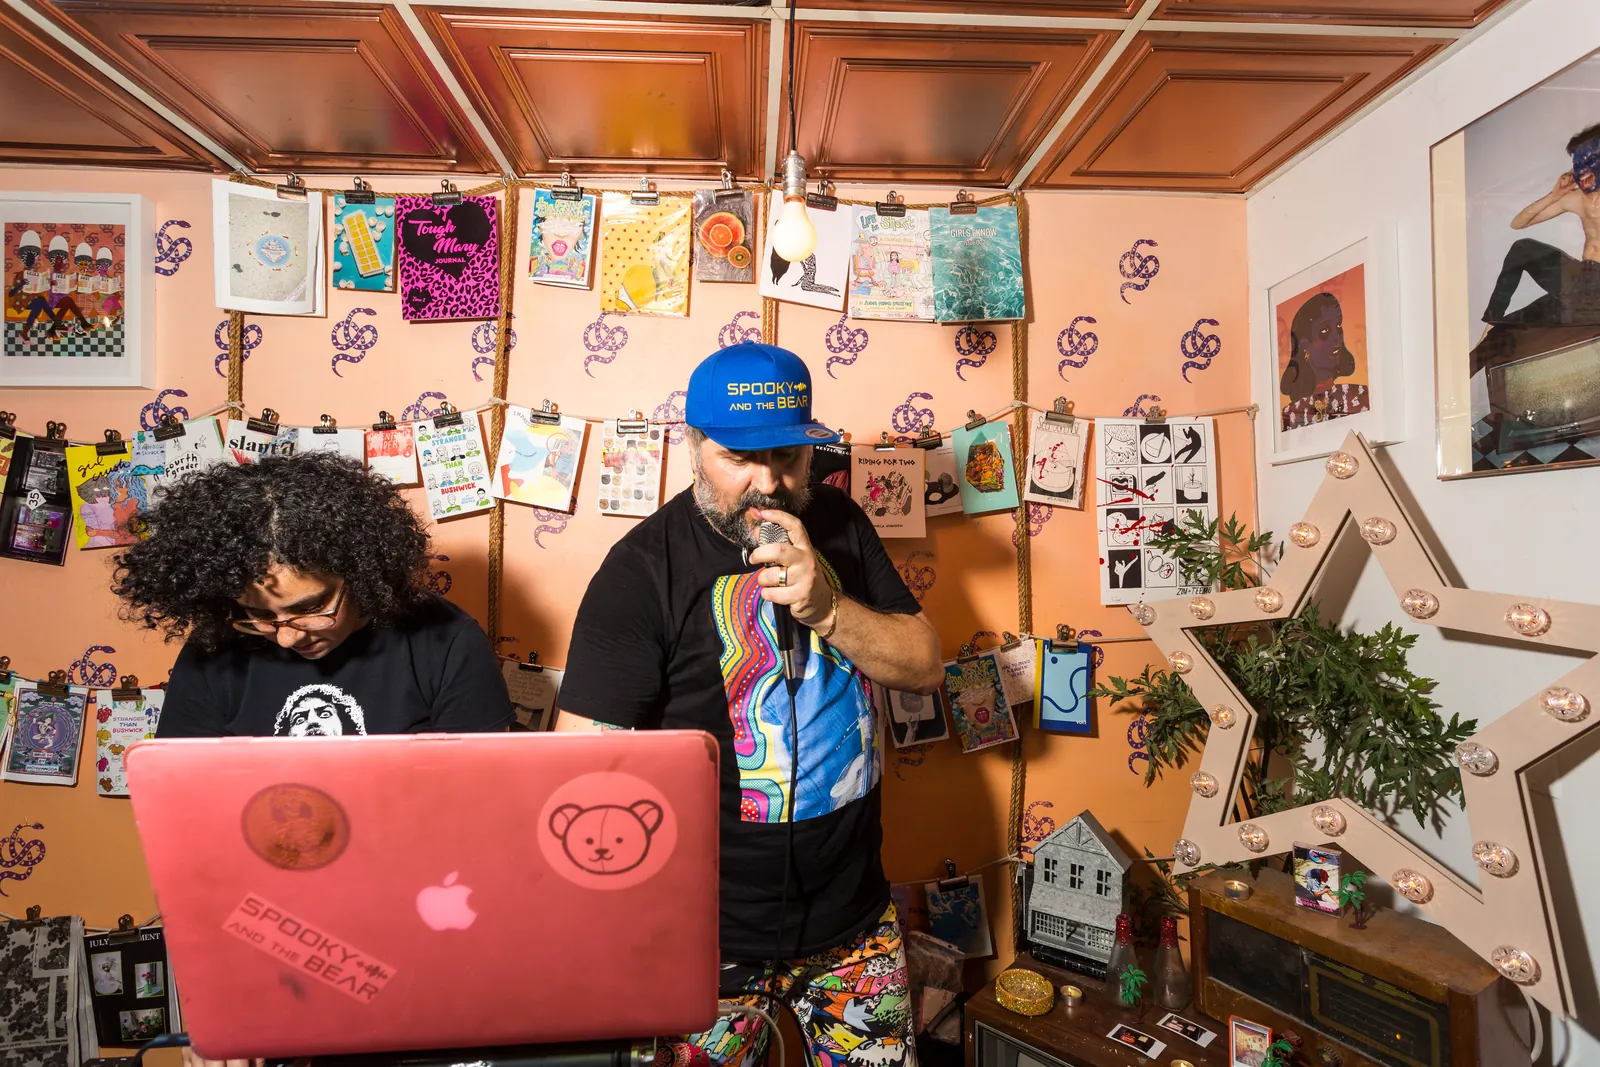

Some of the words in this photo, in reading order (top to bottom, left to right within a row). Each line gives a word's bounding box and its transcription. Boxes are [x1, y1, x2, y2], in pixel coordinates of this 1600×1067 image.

[408, 219, 456, 239] Tough
[950, 228, 971, 237] GIRLS
[975, 228, 997, 237] KNOW
[433, 237, 479, 257] Mary
[727, 382, 794, 396] SPOOKY
[729, 402, 752, 411] AND
[756, 402, 775, 410] THE
[777, 395, 808, 409] BEAR
[431, 434, 467, 446] STRANGER
[77, 456, 104, 478] girl
[444, 460, 463, 470] THAN
[858, 457, 881, 466] RIDING
[883, 458, 898, 466] FOR
[899, 458, 916, 466] TWO
[440, 482, 477, 495] BUSHWICK
[29, 492, 40, 507] 35
[239, 897, 360, 963] SPOOKY
[89, 938, 110, 948] JULY
[227, 922, 265, 944] AND
[271, 941, 301, 963] THE
[303, 955, 379, 1000] BEAR
